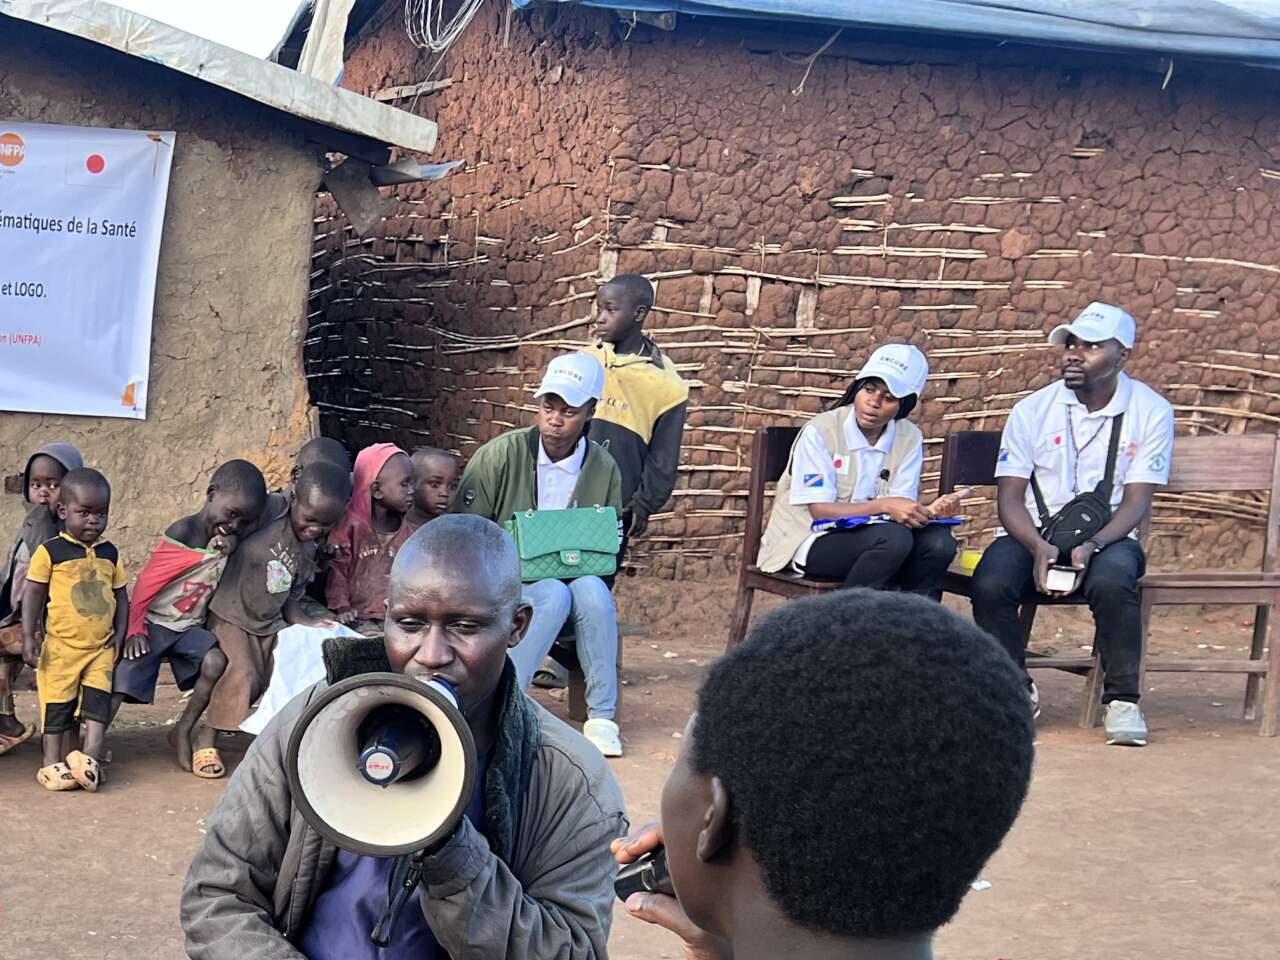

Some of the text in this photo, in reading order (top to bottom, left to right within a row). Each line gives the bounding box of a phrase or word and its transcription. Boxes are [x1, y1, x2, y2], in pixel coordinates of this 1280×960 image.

[67, 216, 84, 234] de
[86, 217, 98, 235] la
[101, 219, 137, 238] Santé
[1, 282, 13, 297] et
[14, 281, 47, 298] LOGO.
[9, 334, 41, 346] (UNFPA)
